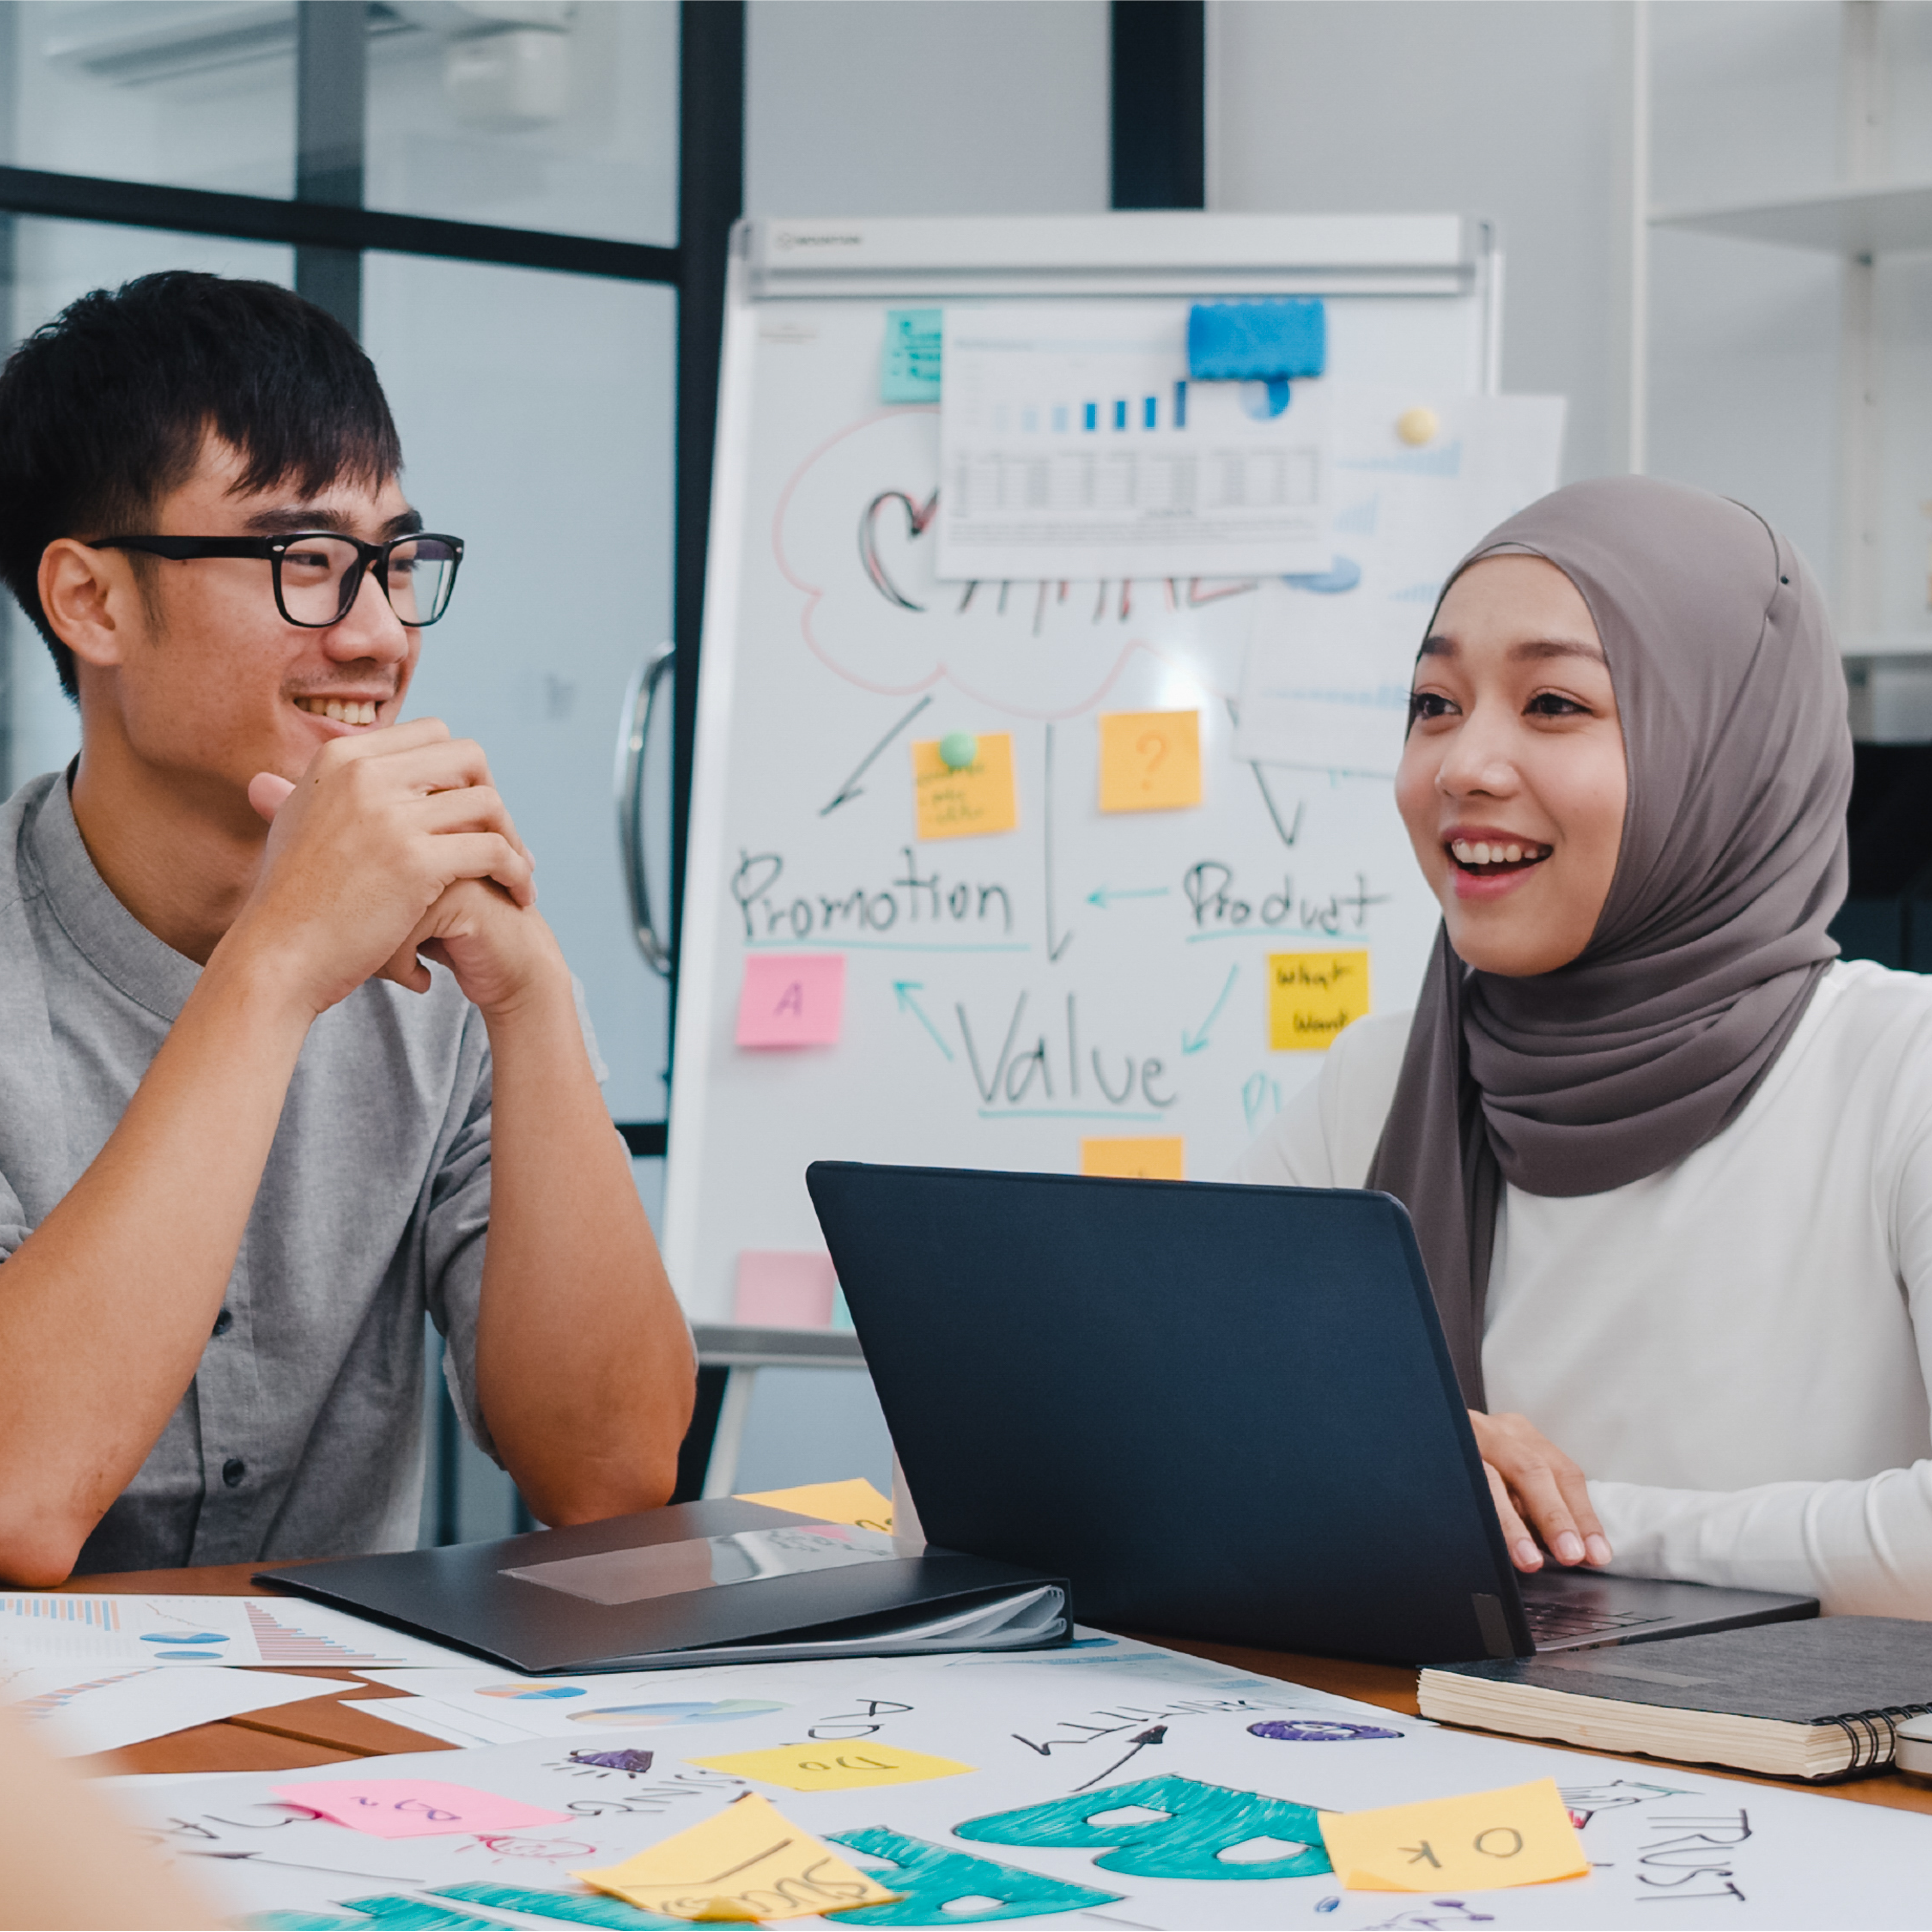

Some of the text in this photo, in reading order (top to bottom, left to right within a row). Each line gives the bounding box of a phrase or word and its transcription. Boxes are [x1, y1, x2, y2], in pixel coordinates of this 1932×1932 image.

[731, 846, 1013, 941] Promotion
[1183, 860, 1391, 935] Product
[774, 981, 805, 1018] A
[956, 989, 1177, 1108] Value
[1397, 1826, 1523, 1868] OK
[1634, 1808, 1753, 1902] TRUST
